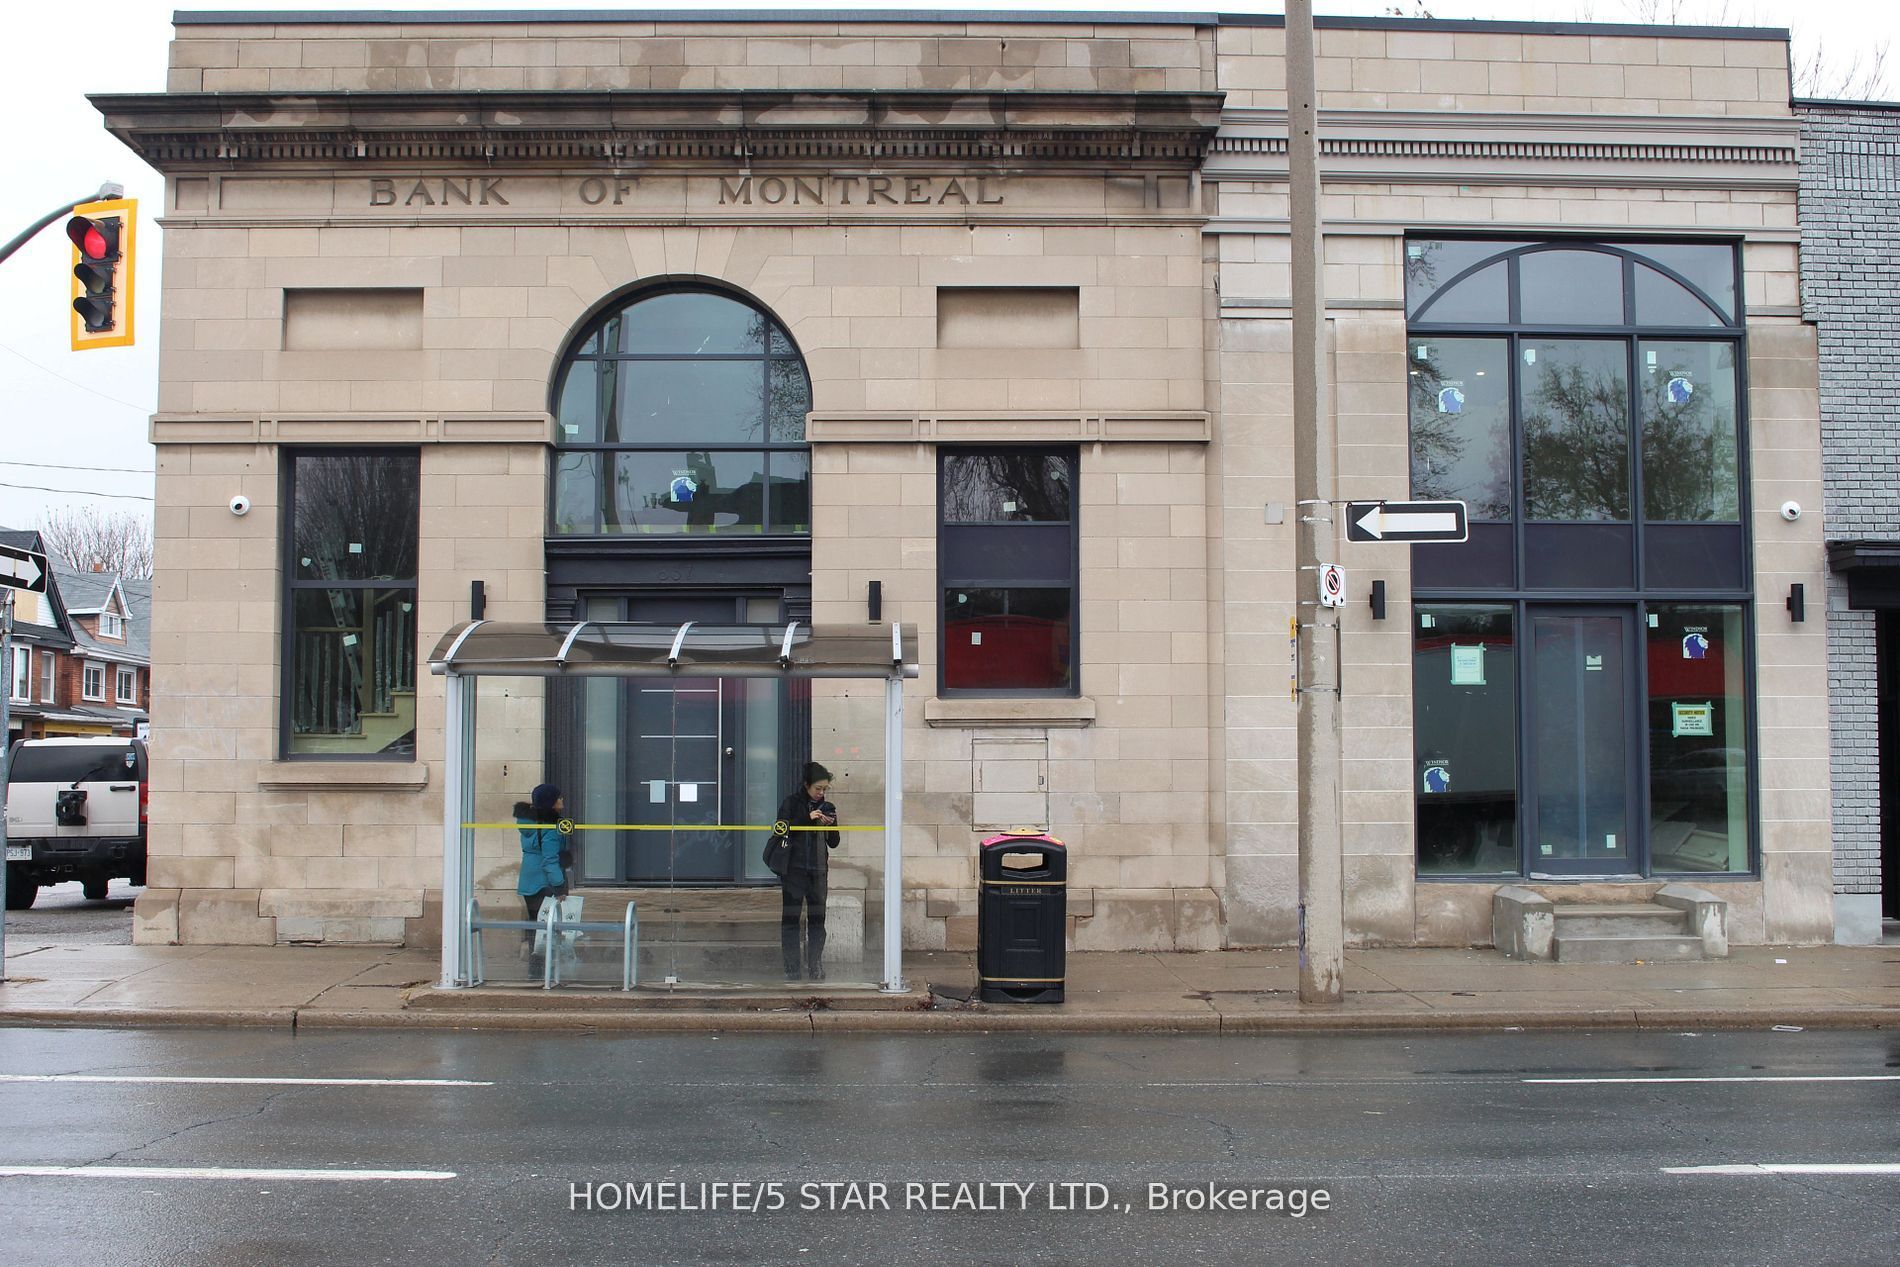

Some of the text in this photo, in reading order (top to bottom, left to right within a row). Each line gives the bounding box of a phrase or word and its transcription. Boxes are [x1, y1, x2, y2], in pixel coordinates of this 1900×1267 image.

[369, 176, 1004, 206] BANK OF MONTREAL
